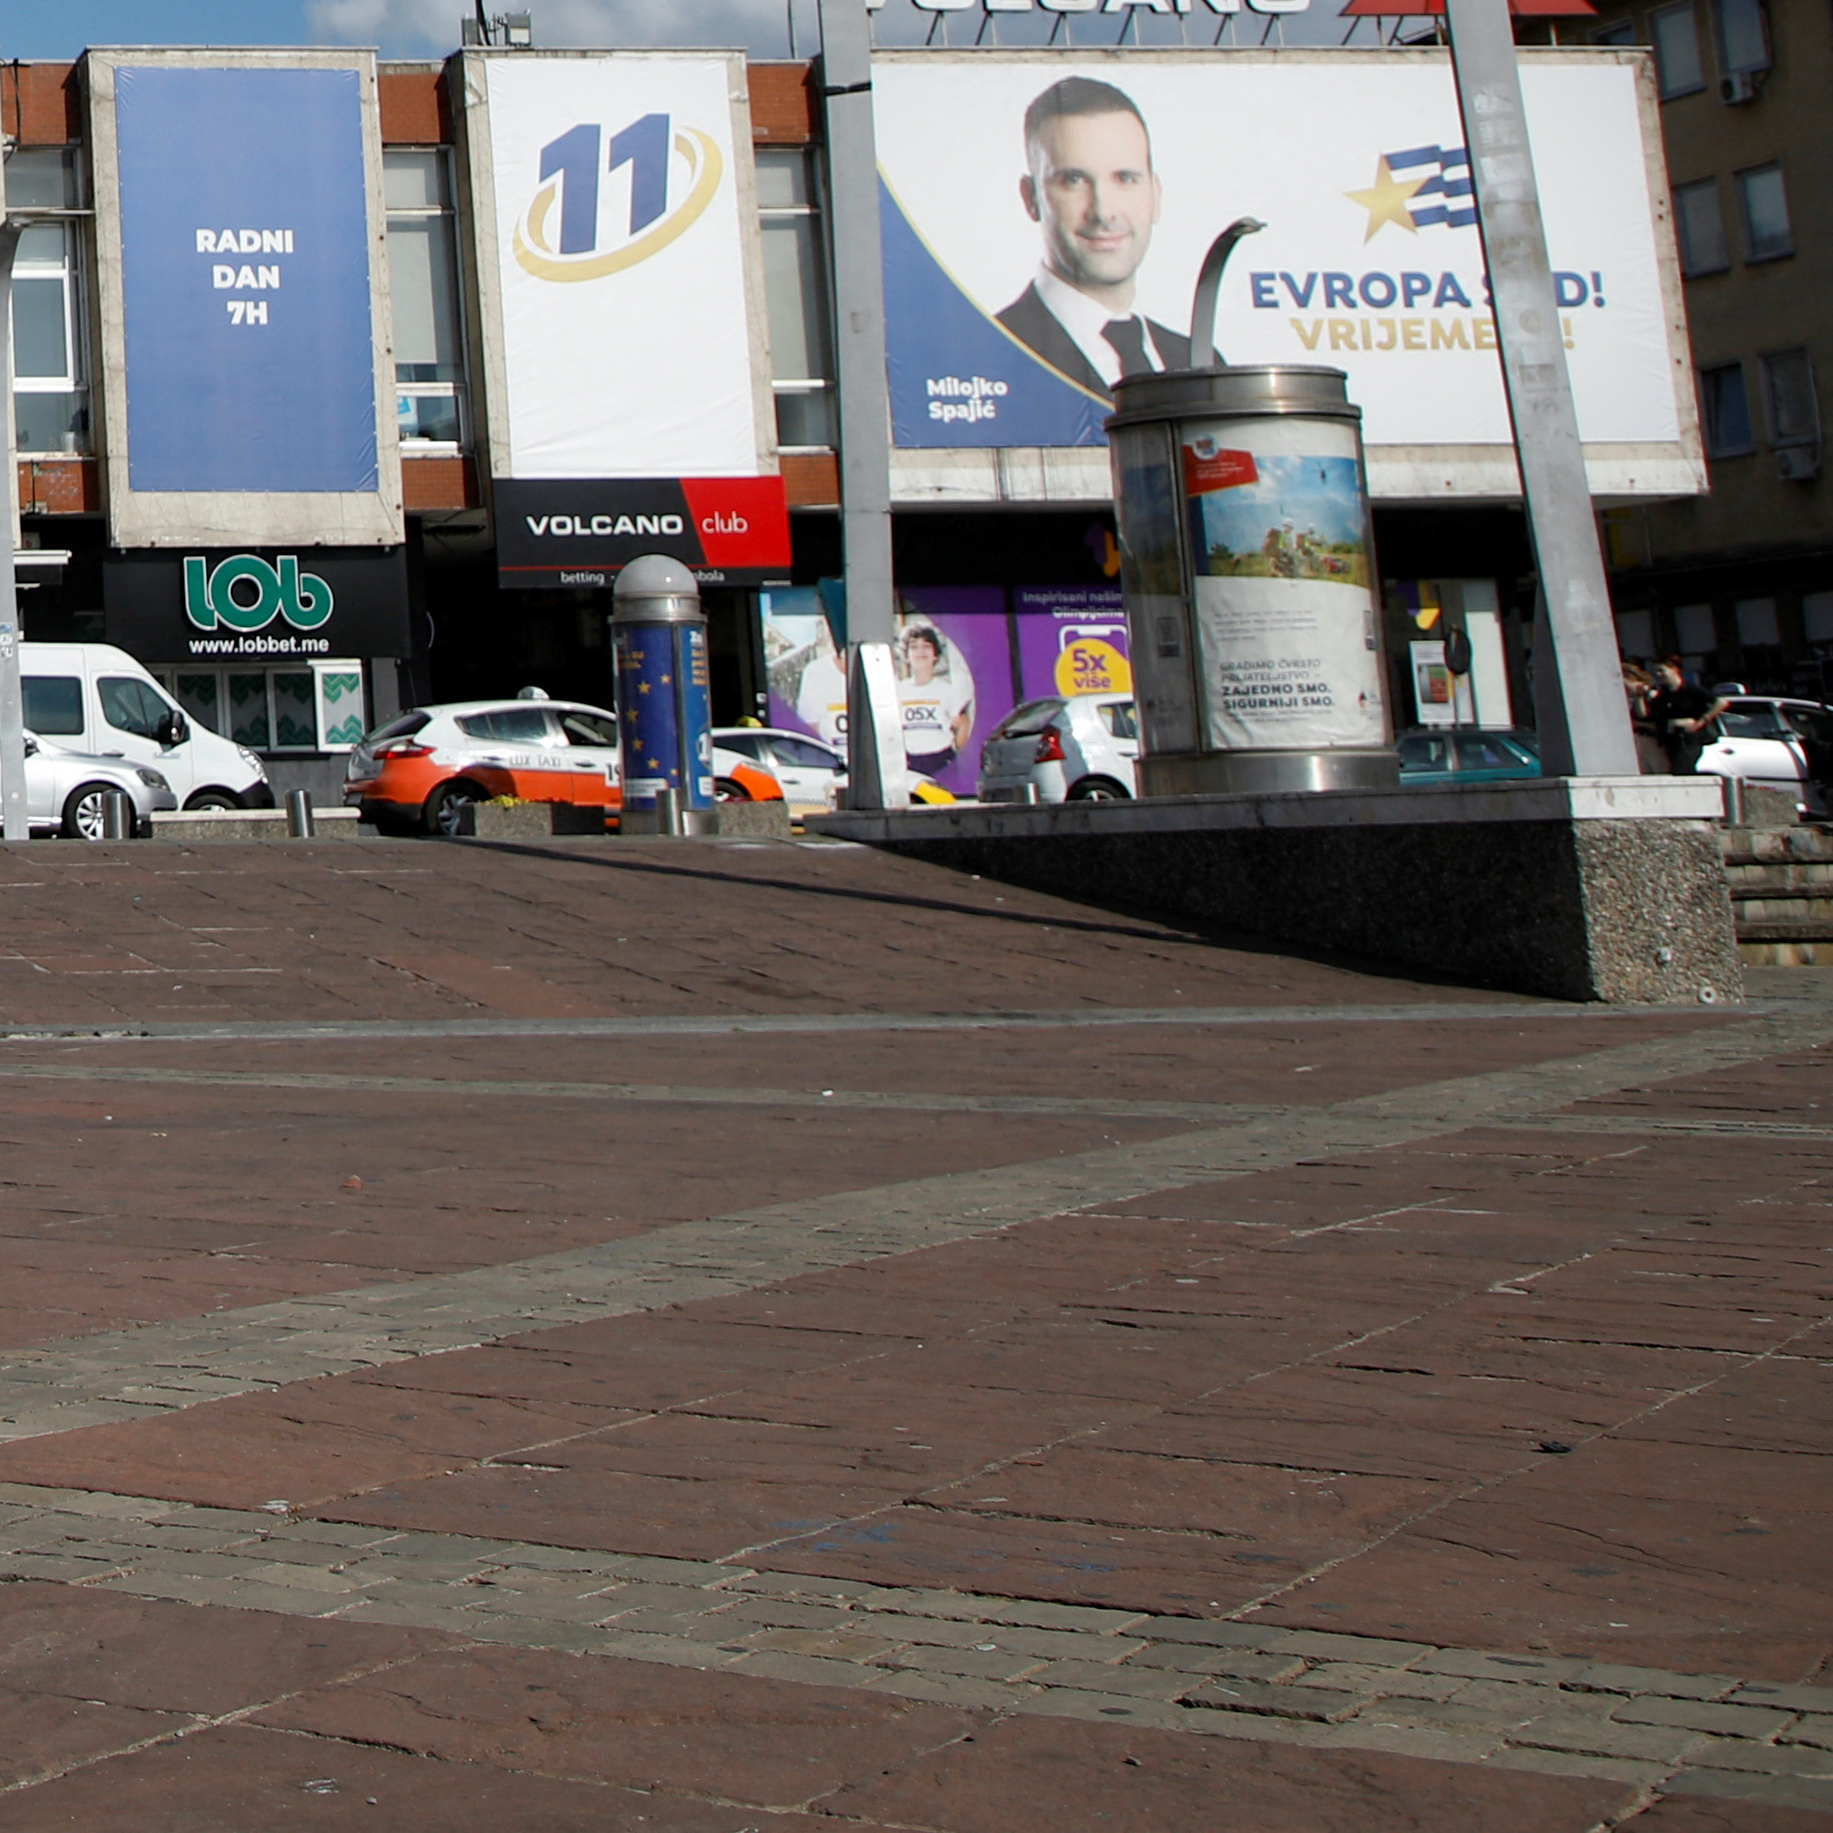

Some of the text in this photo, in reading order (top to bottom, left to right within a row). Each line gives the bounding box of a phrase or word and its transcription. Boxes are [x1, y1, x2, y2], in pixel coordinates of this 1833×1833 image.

[540, 112, 671, 255] 11
[195, 228, 295, 255] RADNI
[212, 264, 280, 290] DAN
[1249, 271, 1472, 309] EVROPA
[226, 300, 268, 326] 7H
[1289, 317, 1499, 351] VRIJEME
[927, 376, 1008, 402] Milojko
[928, 398, 996, 425] Spajić
[526, 509, 749, 537] VOLCANO club
[560, 570, 605, 585] betting
[1022, 591, 1087, 605] Inspirisani
[189, 635, 330, 654] www.lobbet.me
[1072, 648, 1108, 673] 5x
[1220, 658, 1321, 671] GRADIMO ČVRSTO
[1073, 673, 1112, 689] više
[1221, 682, 1332, 696] ZAJEDNO SMO.
[1223, 695, 1335, 710] SIGURNIJI SMO.
[509, 752, 562, 767] LUX TAXI
